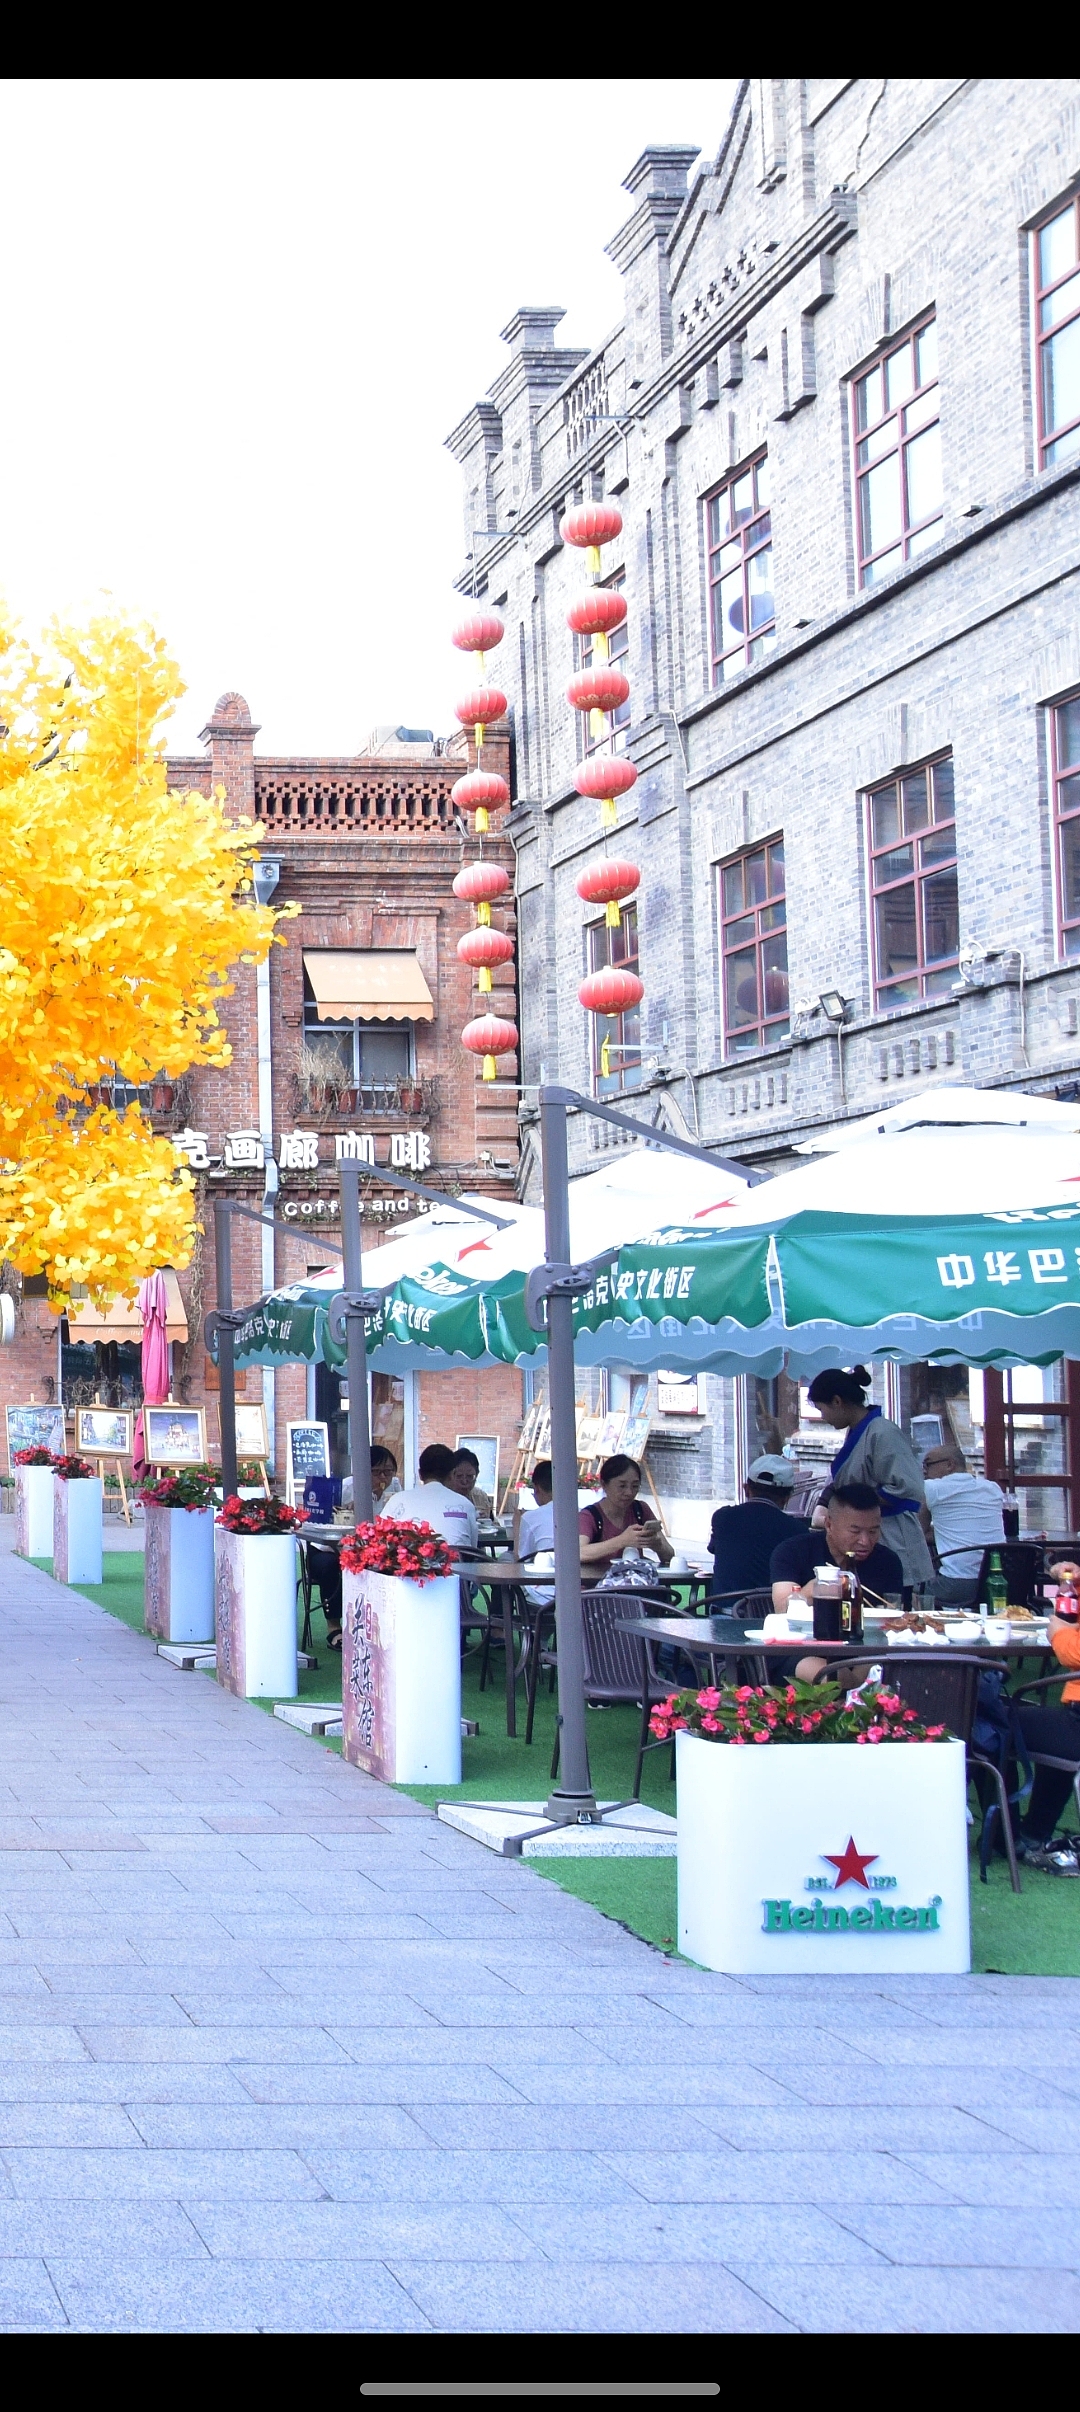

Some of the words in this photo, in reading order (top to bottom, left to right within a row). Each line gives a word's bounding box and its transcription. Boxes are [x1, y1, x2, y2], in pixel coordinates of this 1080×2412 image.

[172, 1128, 431, 1171] 克画廊咖啡
[284, 1199, 364, 1216] Coffe
[372, 1197, 409, 1212] and
[417, 1196, 440, 1213] te
[936, 1248, 1080, 1289] 中华巴
[763, 1898, 940, 1931] Heineken
